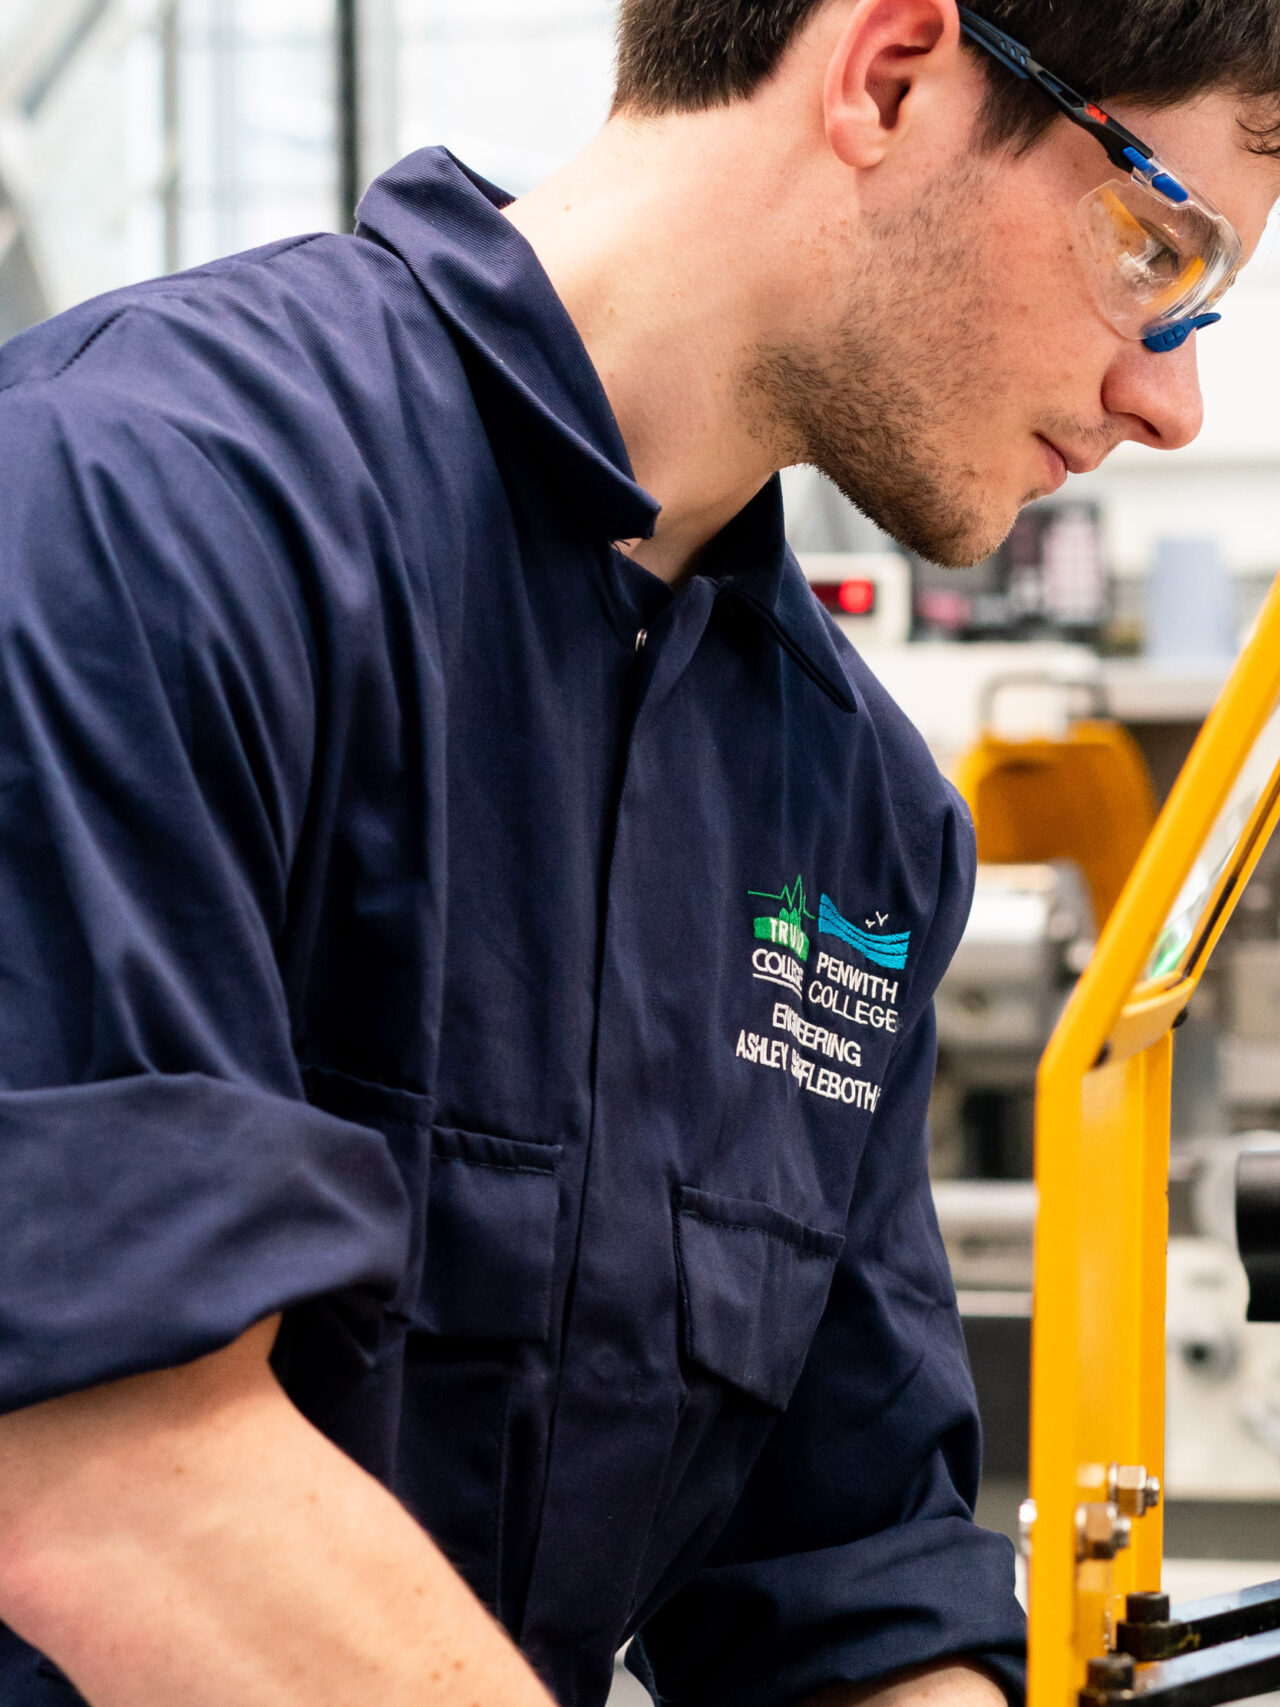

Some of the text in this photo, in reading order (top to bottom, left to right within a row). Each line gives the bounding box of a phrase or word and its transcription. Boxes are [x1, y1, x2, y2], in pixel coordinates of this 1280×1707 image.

[816, 952, 899, 1004] PENWITH
[808, 981, 899, 1033] COLLEGE
[735, 1029, 789, 1071] ASHLEY
